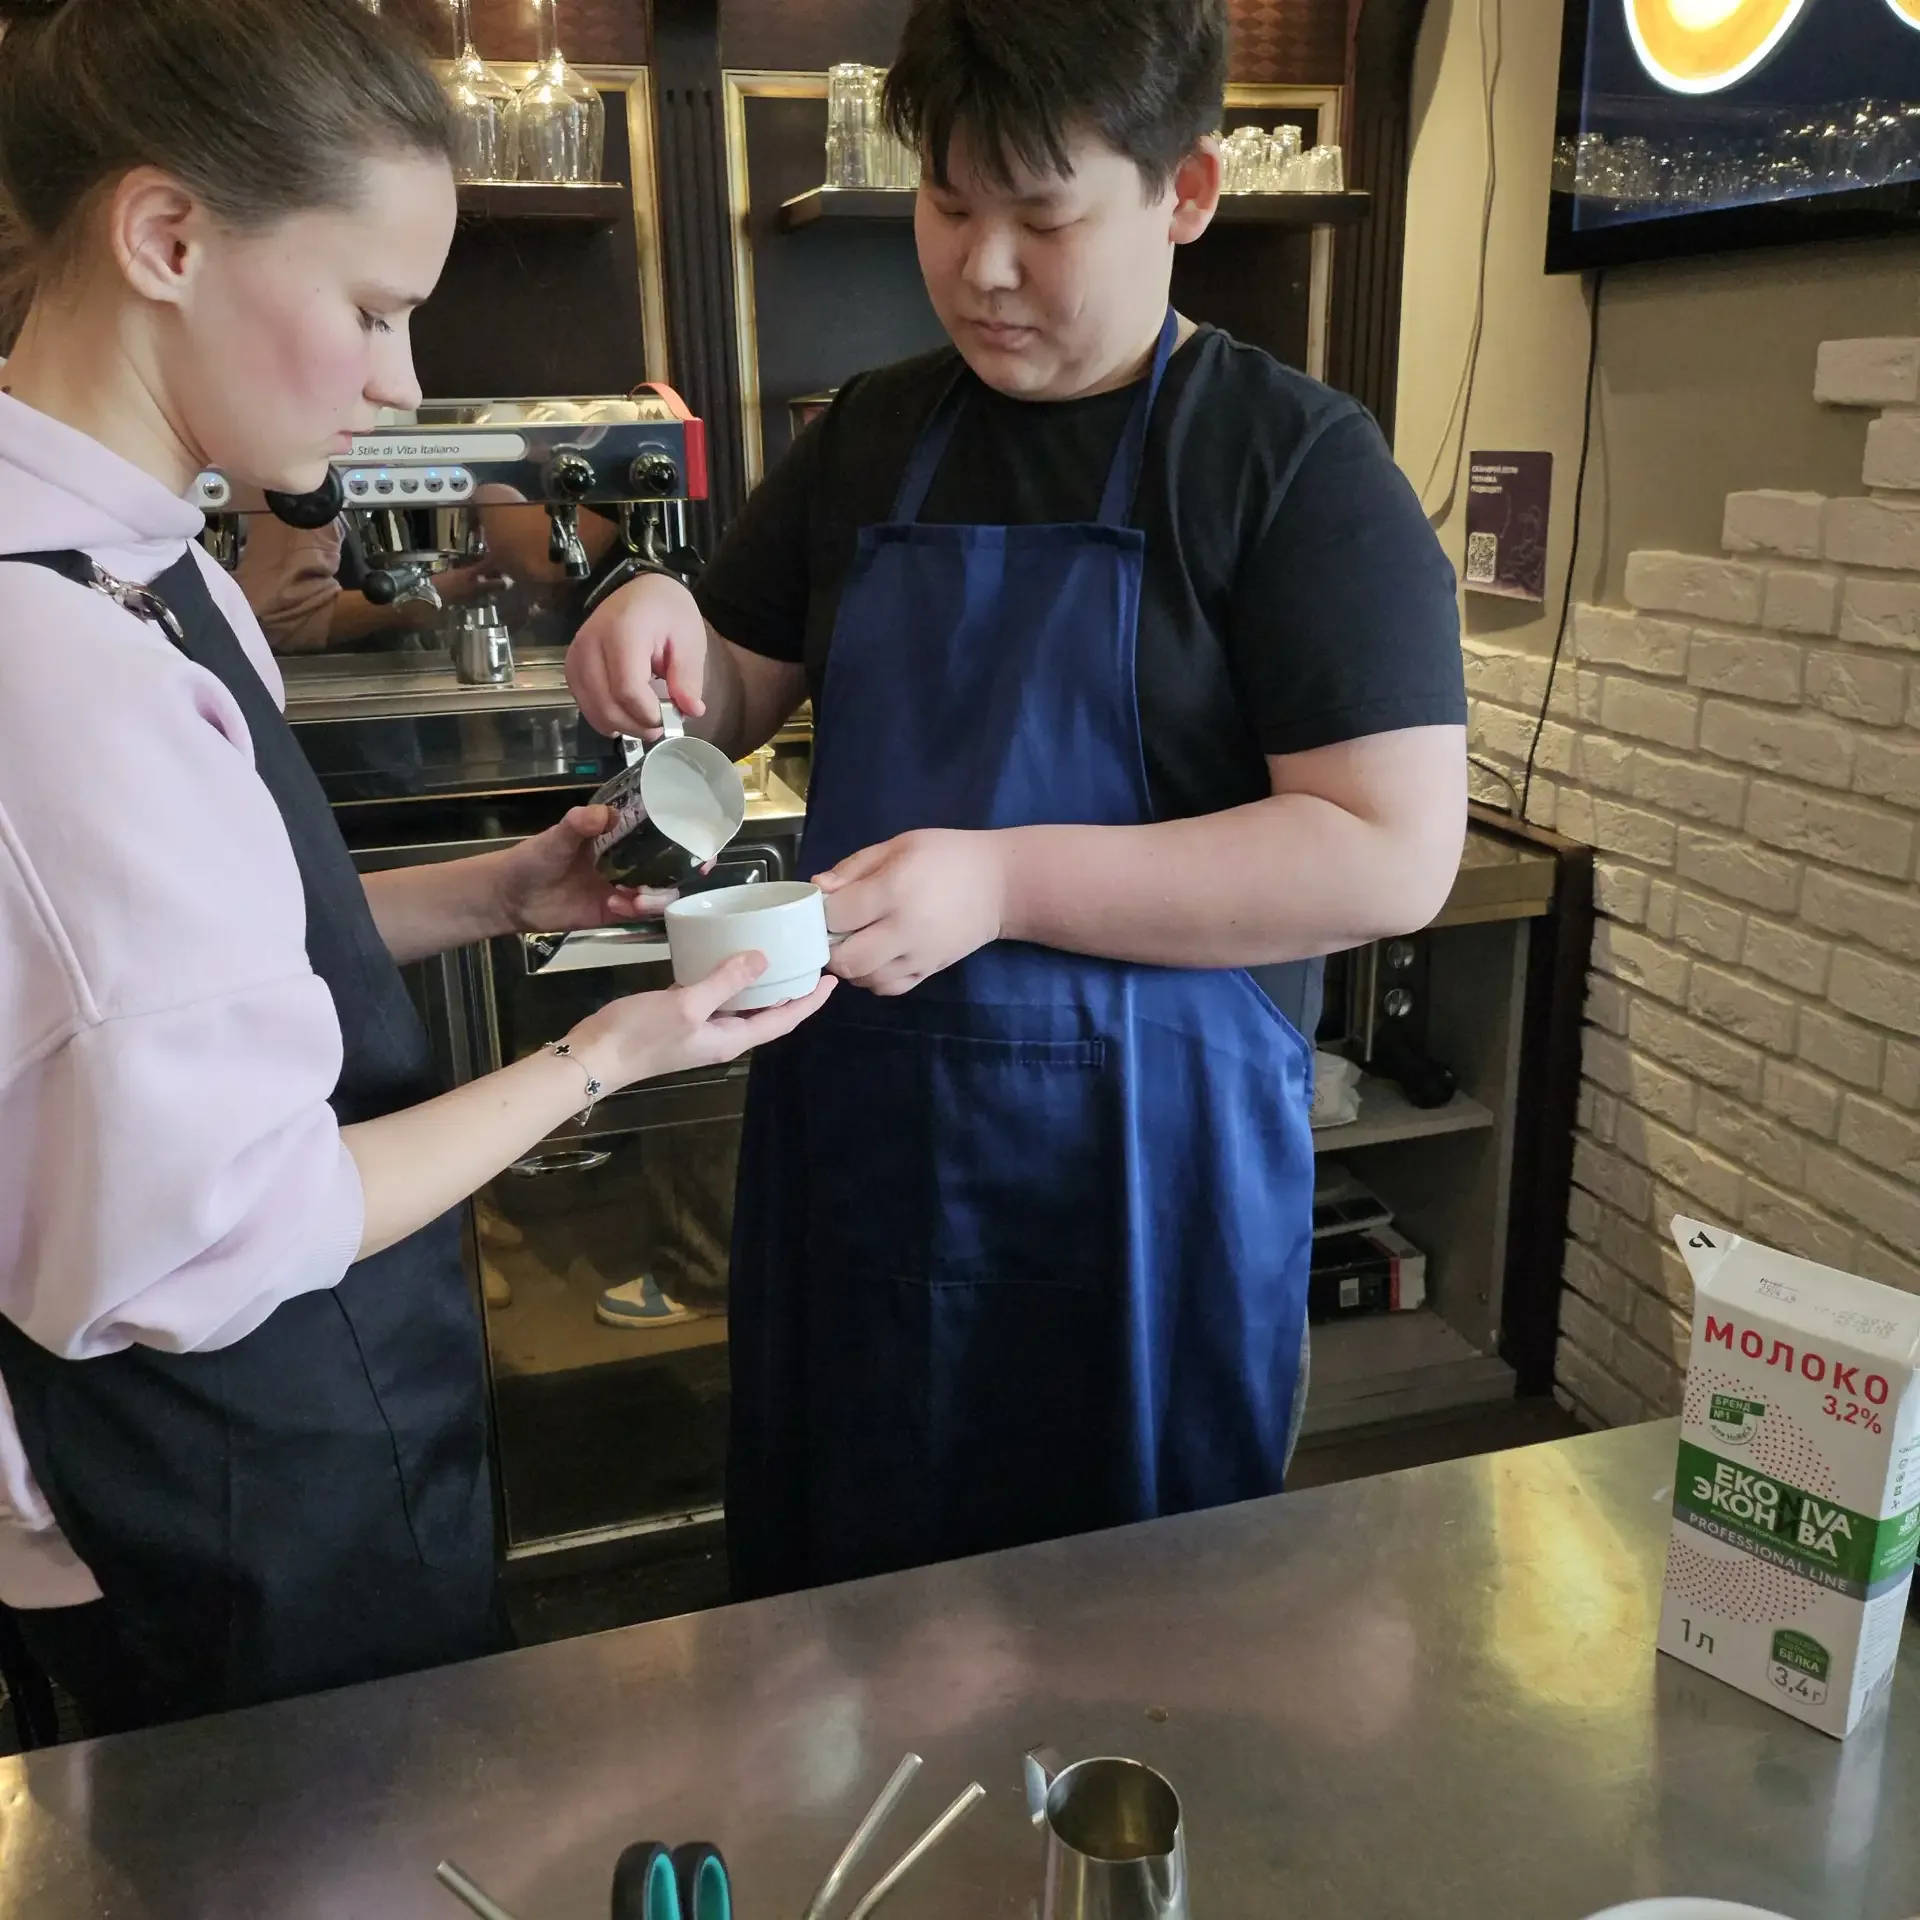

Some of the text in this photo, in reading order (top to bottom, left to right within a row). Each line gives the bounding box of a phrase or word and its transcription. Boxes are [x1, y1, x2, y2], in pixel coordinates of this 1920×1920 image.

[358, 446, 380, 456] Stile
[383, 445, 393, 456] di
[397, 445, 417, 455] Vita
[421, 445, 460, 455] Italiano
[1704, 1315, 1889, 1405] МОЛОКО
[1715, 1396, 1751, 1412] БРЕНД
[1822, 1394, 1882, 1434] 3,2%
[1689, 1512, 1804, 1575] PROFESSIONAL
[1809, 1567, 1849, 1592] LINE
[1778, 1647, 1820, 1673] БЕЛКА
